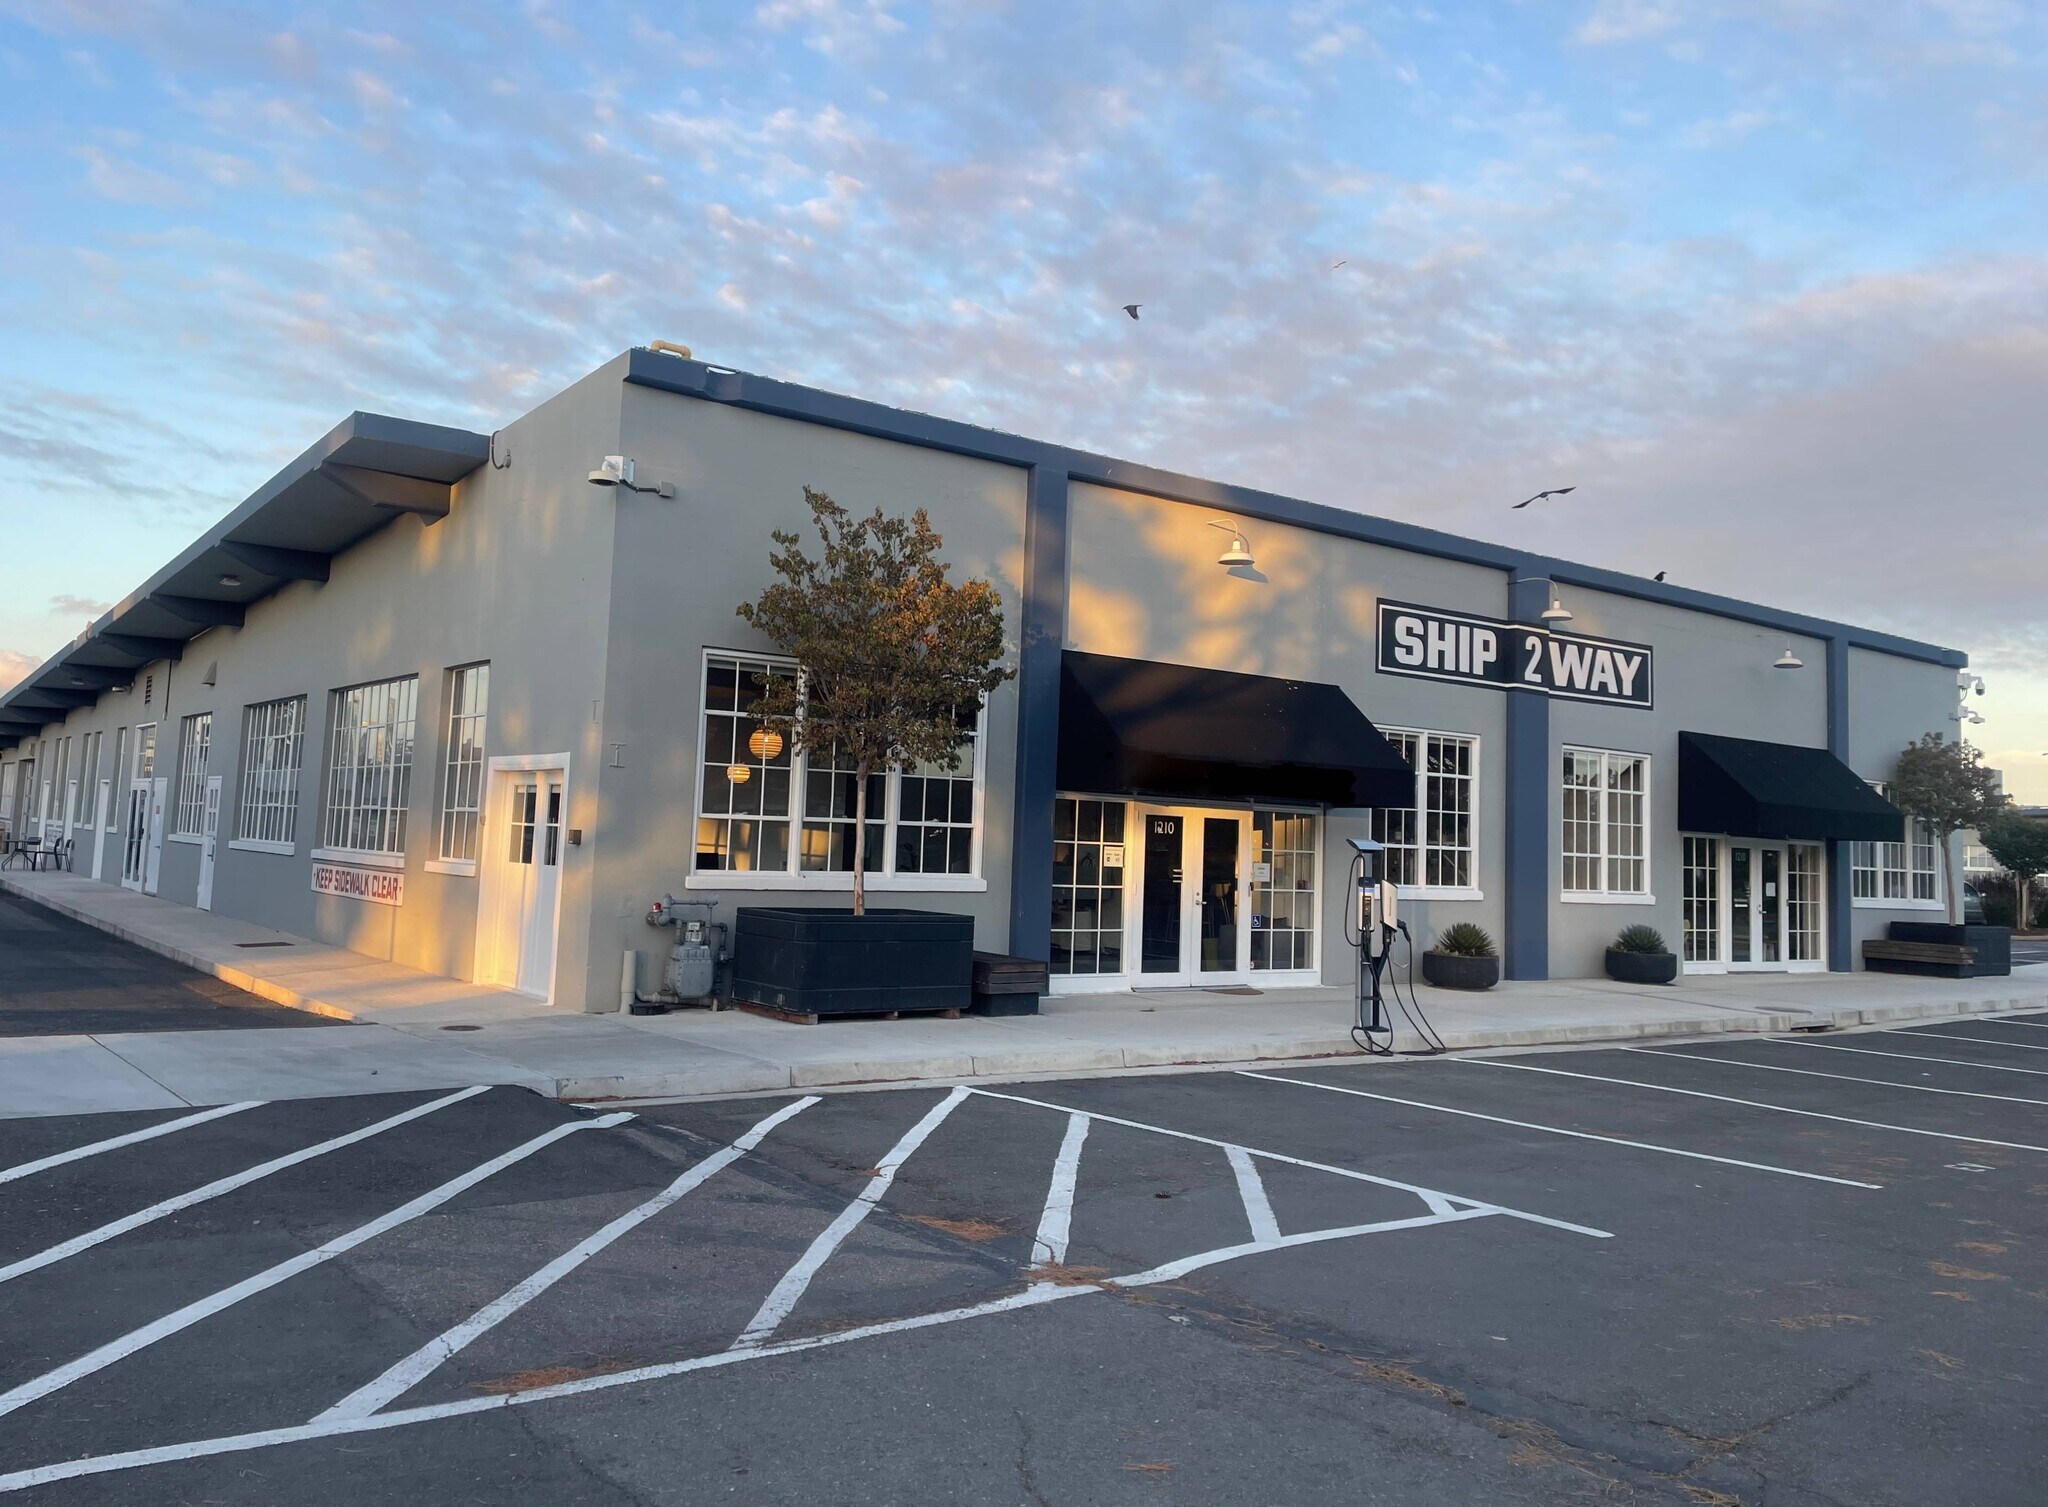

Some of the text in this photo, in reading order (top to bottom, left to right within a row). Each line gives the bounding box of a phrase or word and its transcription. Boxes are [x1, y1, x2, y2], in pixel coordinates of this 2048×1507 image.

[1394, 615, 1497, 676] SHIP
[1154, 820, 1175, 835] 1210
[315, 867, 399, 901] KEEP SIDEWALK CLEAR
